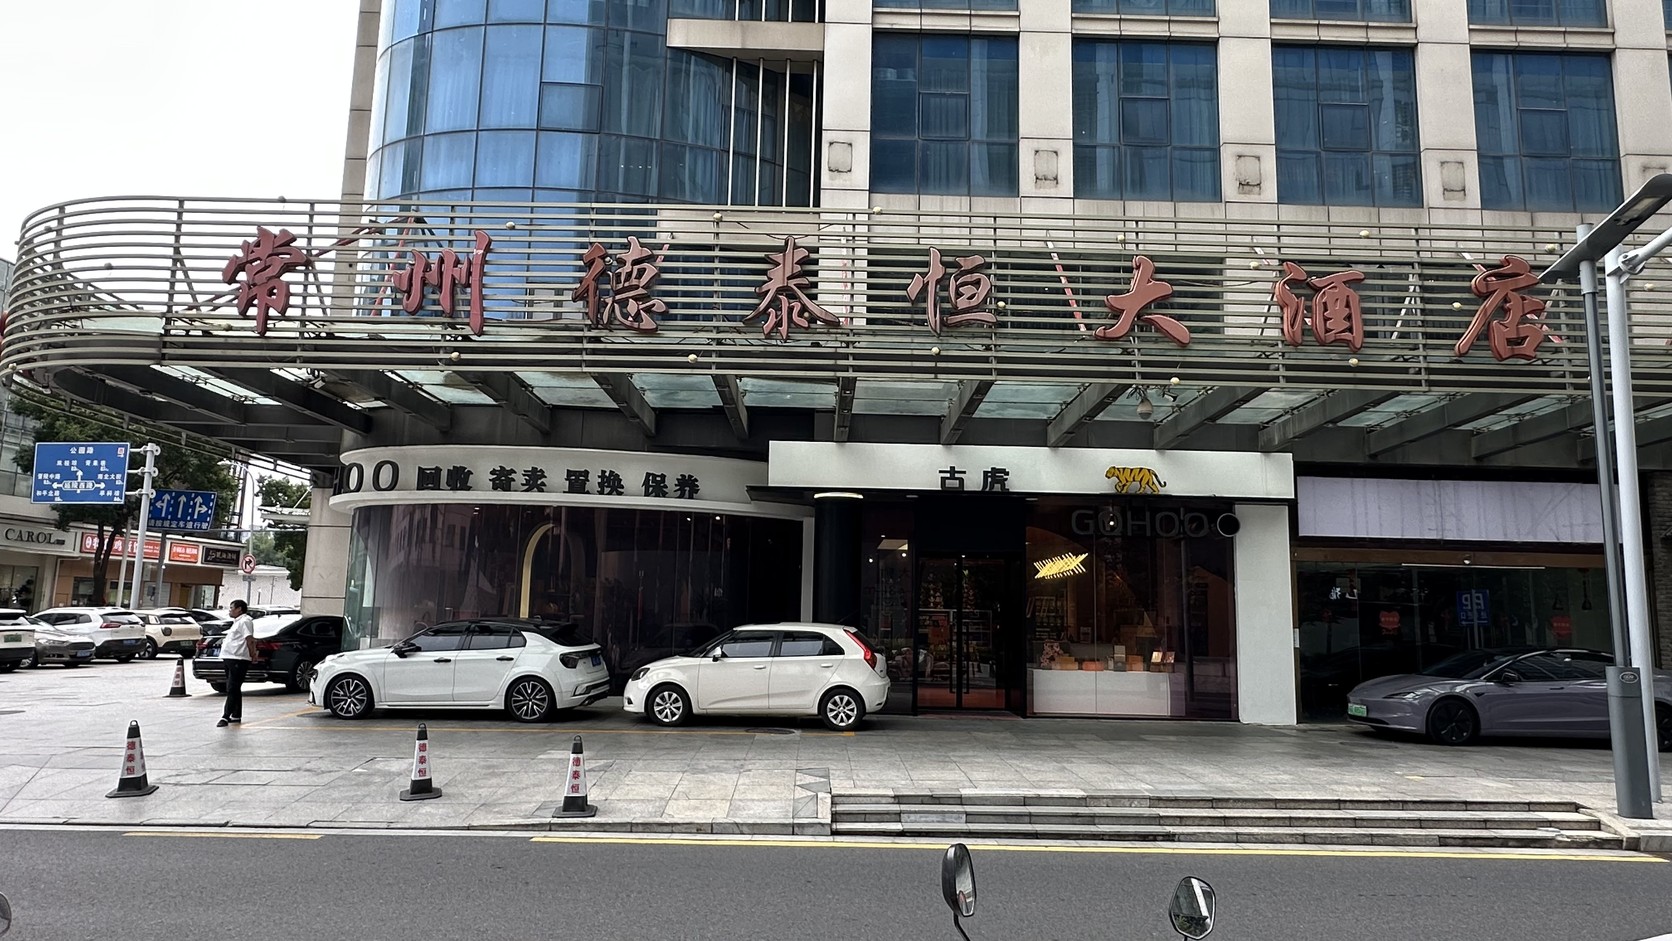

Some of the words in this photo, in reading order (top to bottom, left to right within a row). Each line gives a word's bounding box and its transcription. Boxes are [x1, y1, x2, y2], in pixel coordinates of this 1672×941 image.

[221, 226, 1546, 361] 常州德泰恒大酒店
[416, 466, 473, 490] 回收
[489, 465, 548, 492] 寄卖
[563, 468, 625, 495] 置换
[641, 471, 701, 499] 保养
[938, 466, 1010, 491] 古虎
[4, 528, 55, 544] CAROL
[1071, 509, 1209, 538] GOHOO
[126, 741, 136, 776] 德泰恒
[418, 742, 428, 777] 德泰恒
[571, 756, 581, 793] 德泰恒
